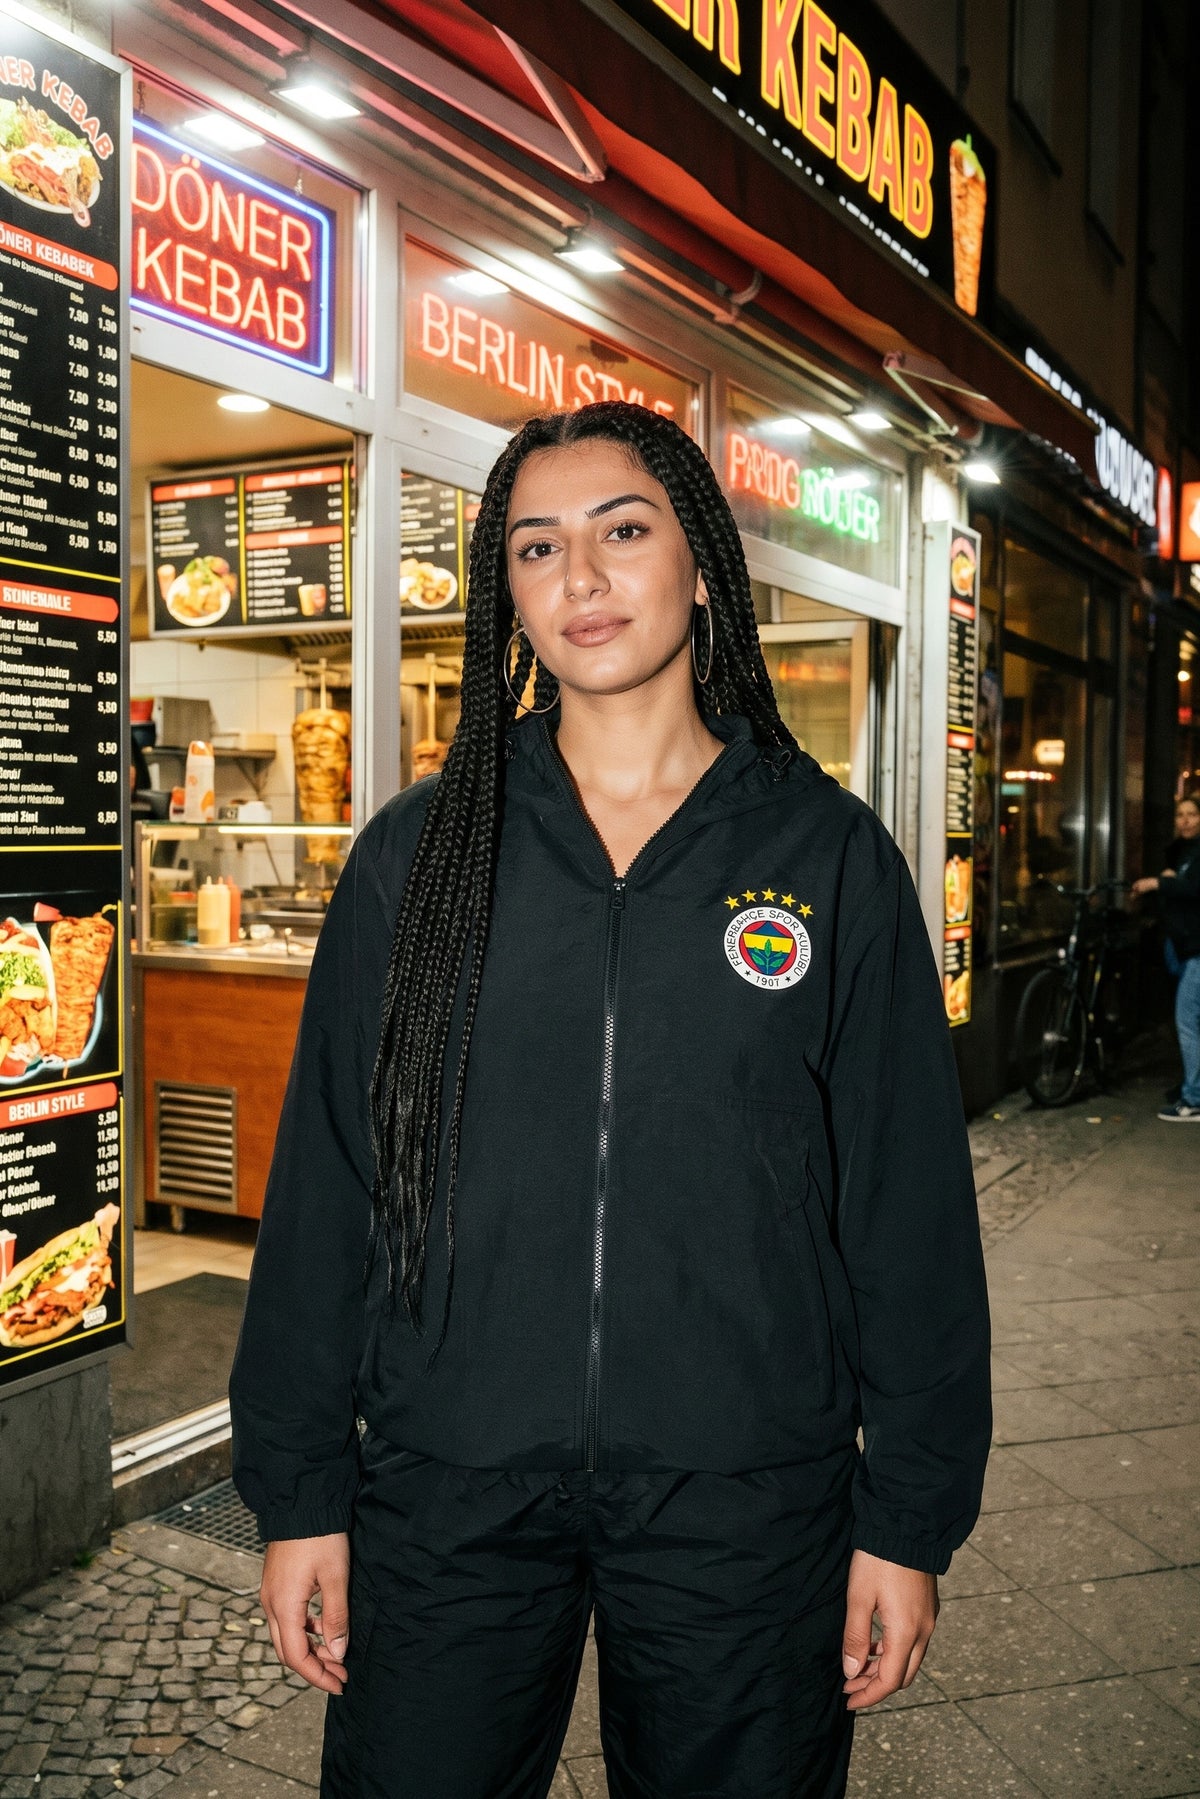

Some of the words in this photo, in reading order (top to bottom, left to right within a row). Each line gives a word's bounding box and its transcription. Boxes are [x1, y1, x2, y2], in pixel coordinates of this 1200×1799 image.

[41, 69, 115, 160] KEBAB
[761, 0, 934, 239] KEBAB
[131, 142, 312, 282] DÖNER
[36, 242, 95, 278] KEBABEK
[137, 227, 306, 350] KEBAB
[422, 292, 564, 408] BERLIN
[727, 910, 766, 967] FENERBAHÇE
[769, 909, 800, 931] SPOR
[794, 932, 810, 977] KULÜBÜ
[756, 976, 781, 987] 1907
[9, 1099, 49, 1122] BERLIN
[51, 1091, 86, 1113] STYLE
